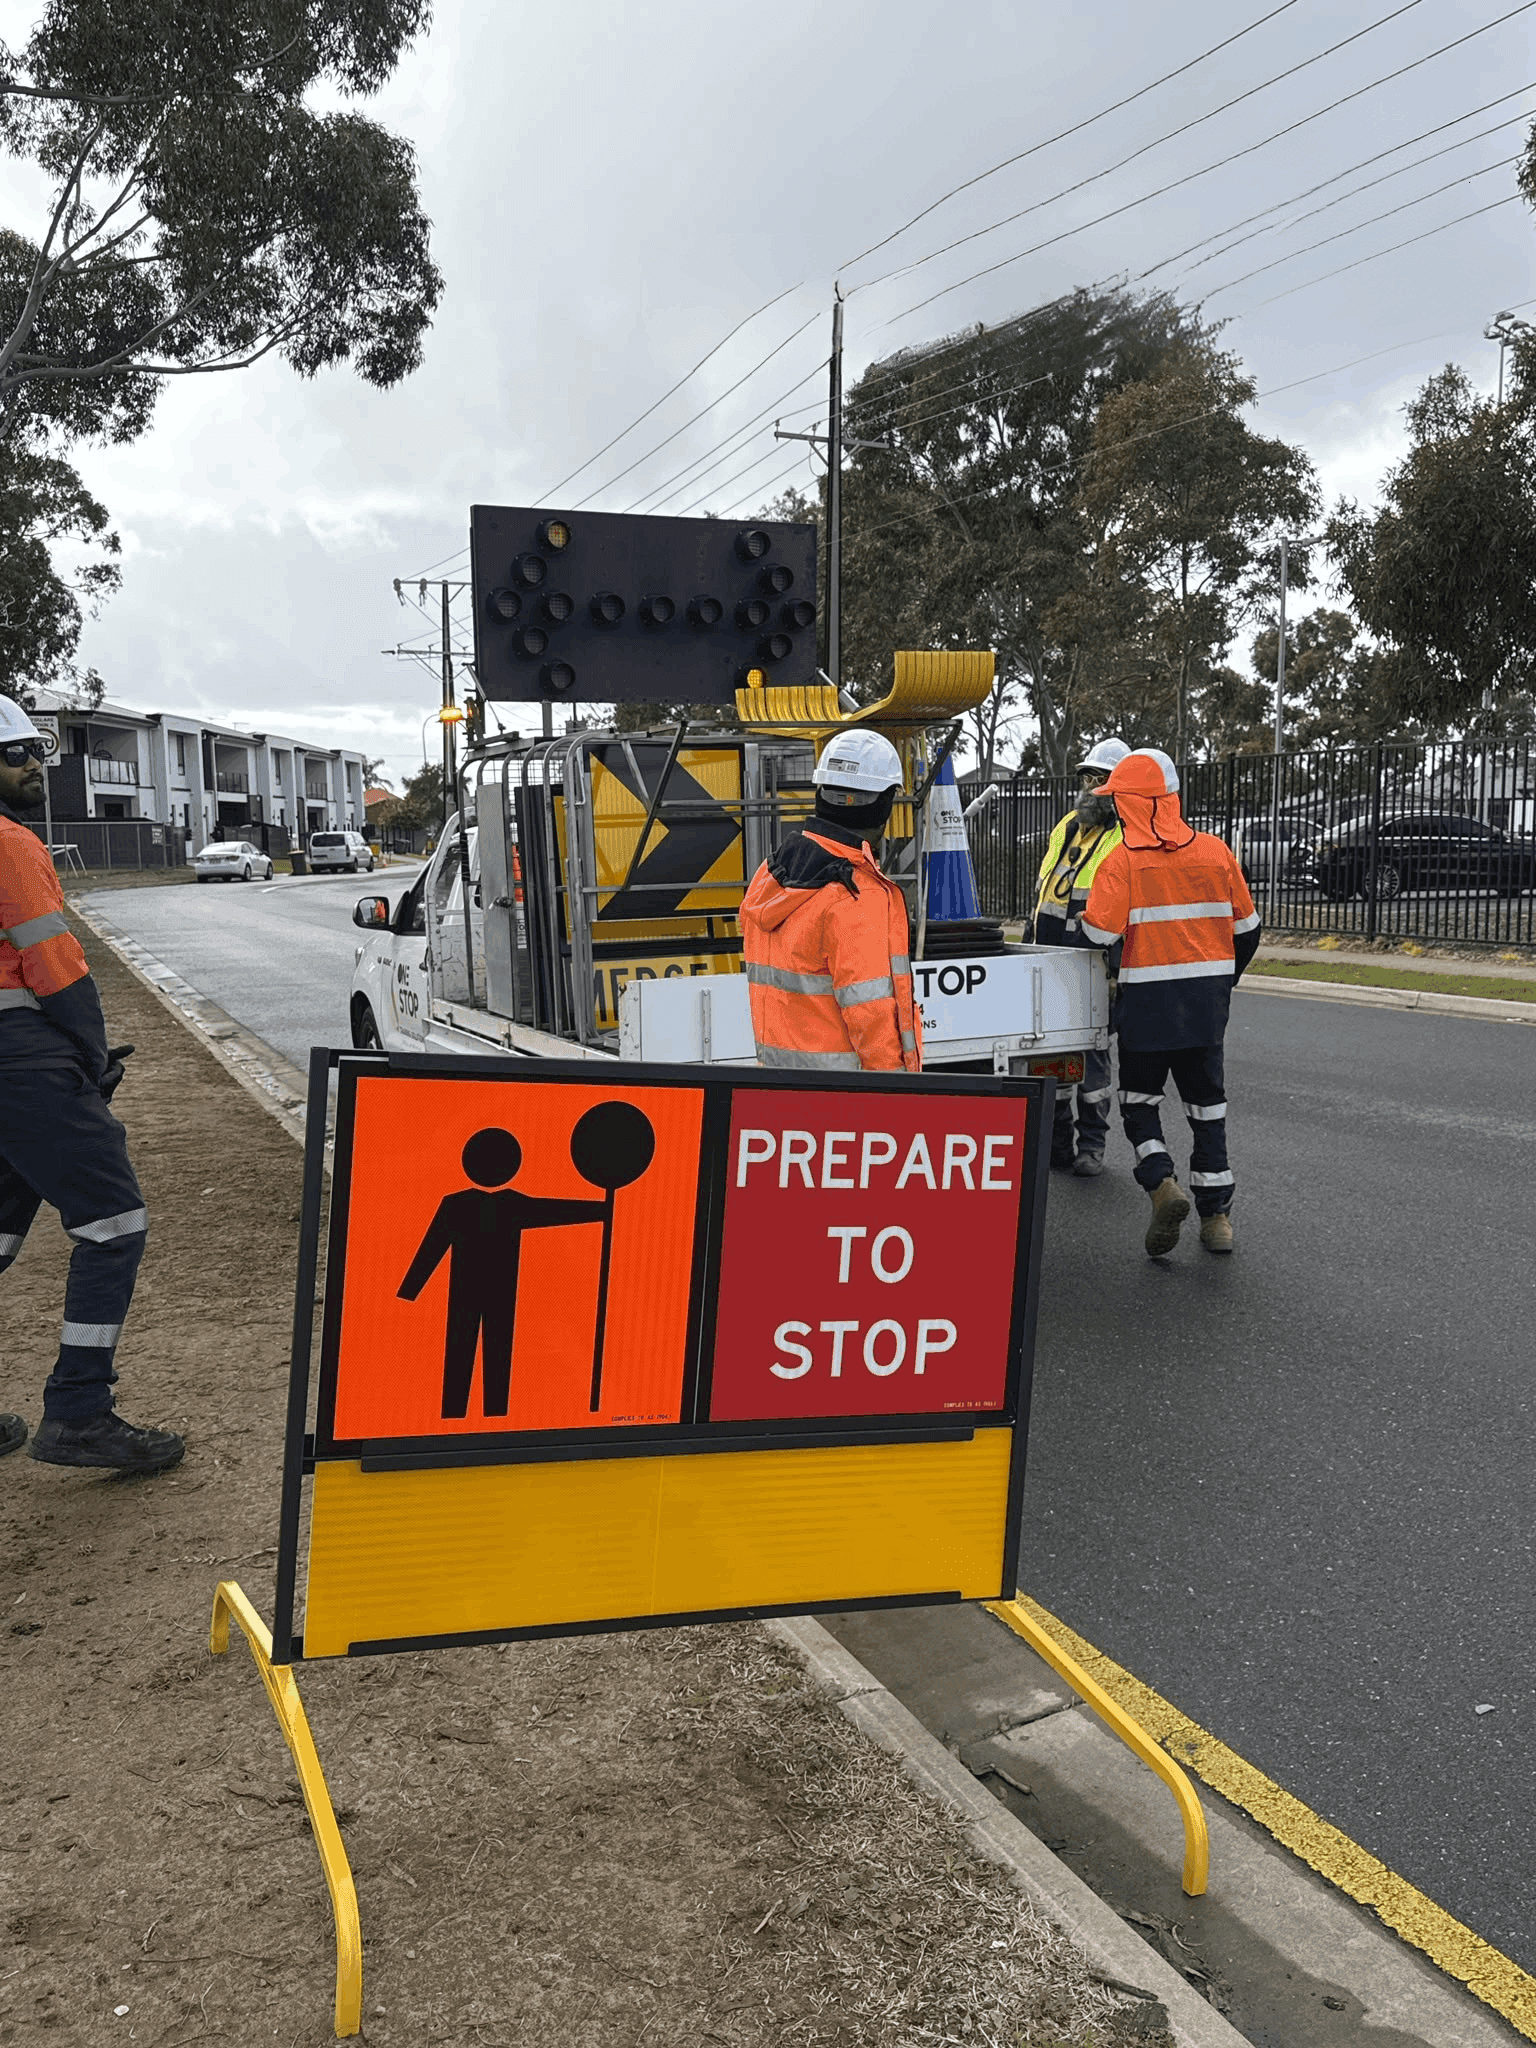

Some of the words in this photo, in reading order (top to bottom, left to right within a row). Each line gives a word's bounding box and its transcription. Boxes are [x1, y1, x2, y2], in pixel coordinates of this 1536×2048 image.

[398, 963, 410, 987] ONE
[916, 965, 986, 998] TOP
[399, 988, 418, 1018] STOP
[737, 1129, 1013, 1190] PREPARE
[827, 1225, 914, 1284] TO
[769, 1319, 957, 1380] STOP
